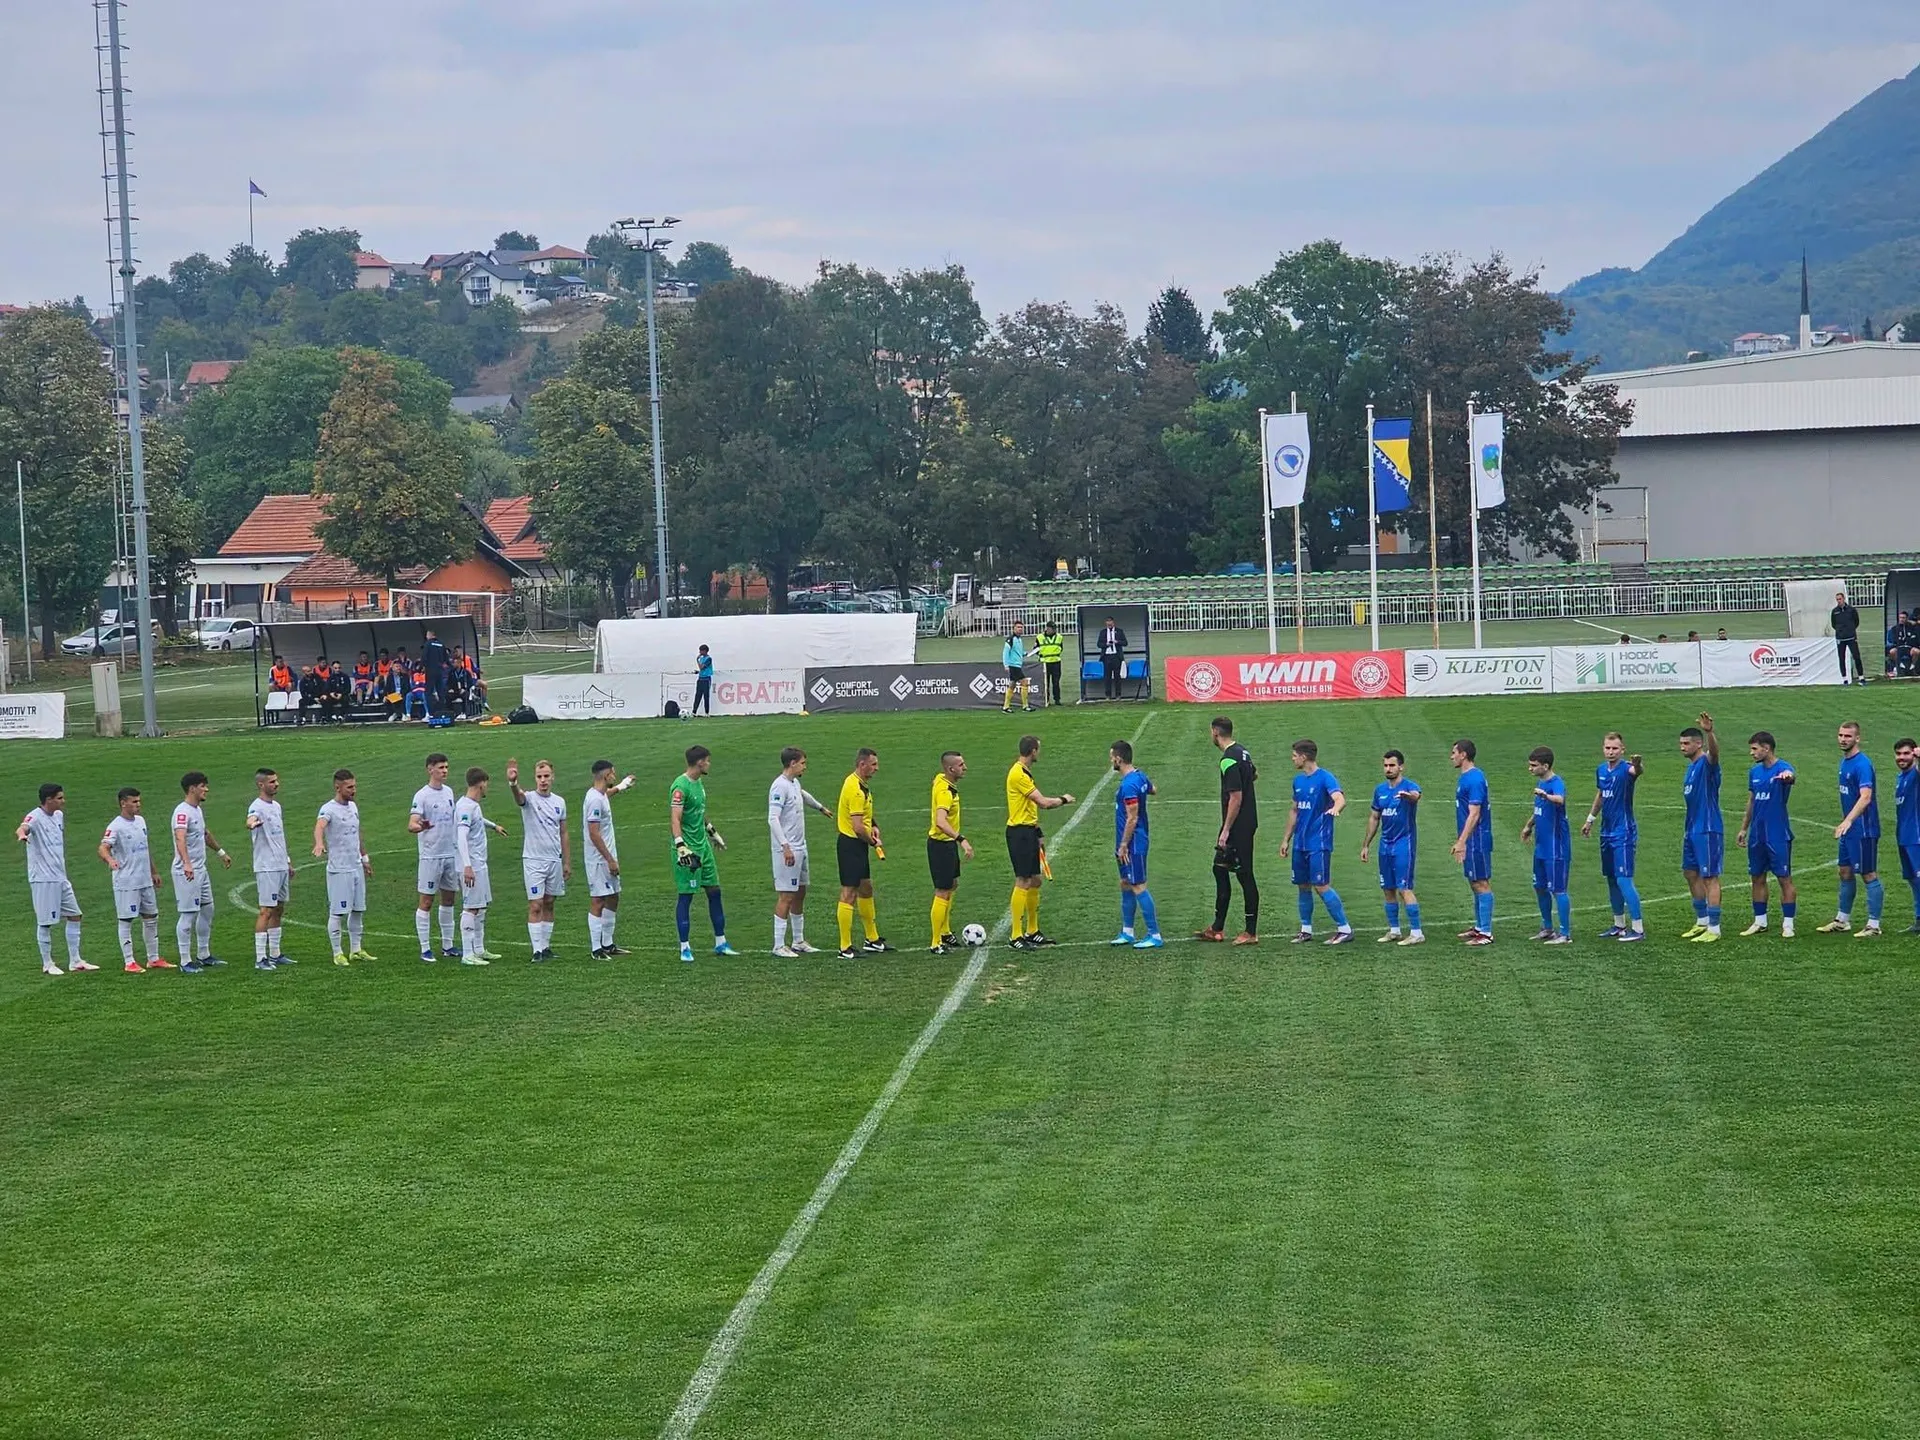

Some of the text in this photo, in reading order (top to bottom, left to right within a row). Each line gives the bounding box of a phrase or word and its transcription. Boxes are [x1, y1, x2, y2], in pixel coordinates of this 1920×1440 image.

[1775, 656, 1788, 664] TIM
[1446, 659, 1545, 674] KLEJTON
[1619, 662, 1678, 675] PROMEX
[835, 681, 873, 689] COMFORT
[915, 679, 952, 687] COMFORT
[1505, 676, 1543, 686] D.O.O
[835, 688, 879, 697] SOLUTIONS
[915, 687, 959, 695] SOLUTIONS
[1254, 687, 1271, 695] LIGA
[1273, 685, 1317, 694] FEDERACIJE
[558, 690, 625, 709] ambienta
[27, 706, 37, 715] TR
